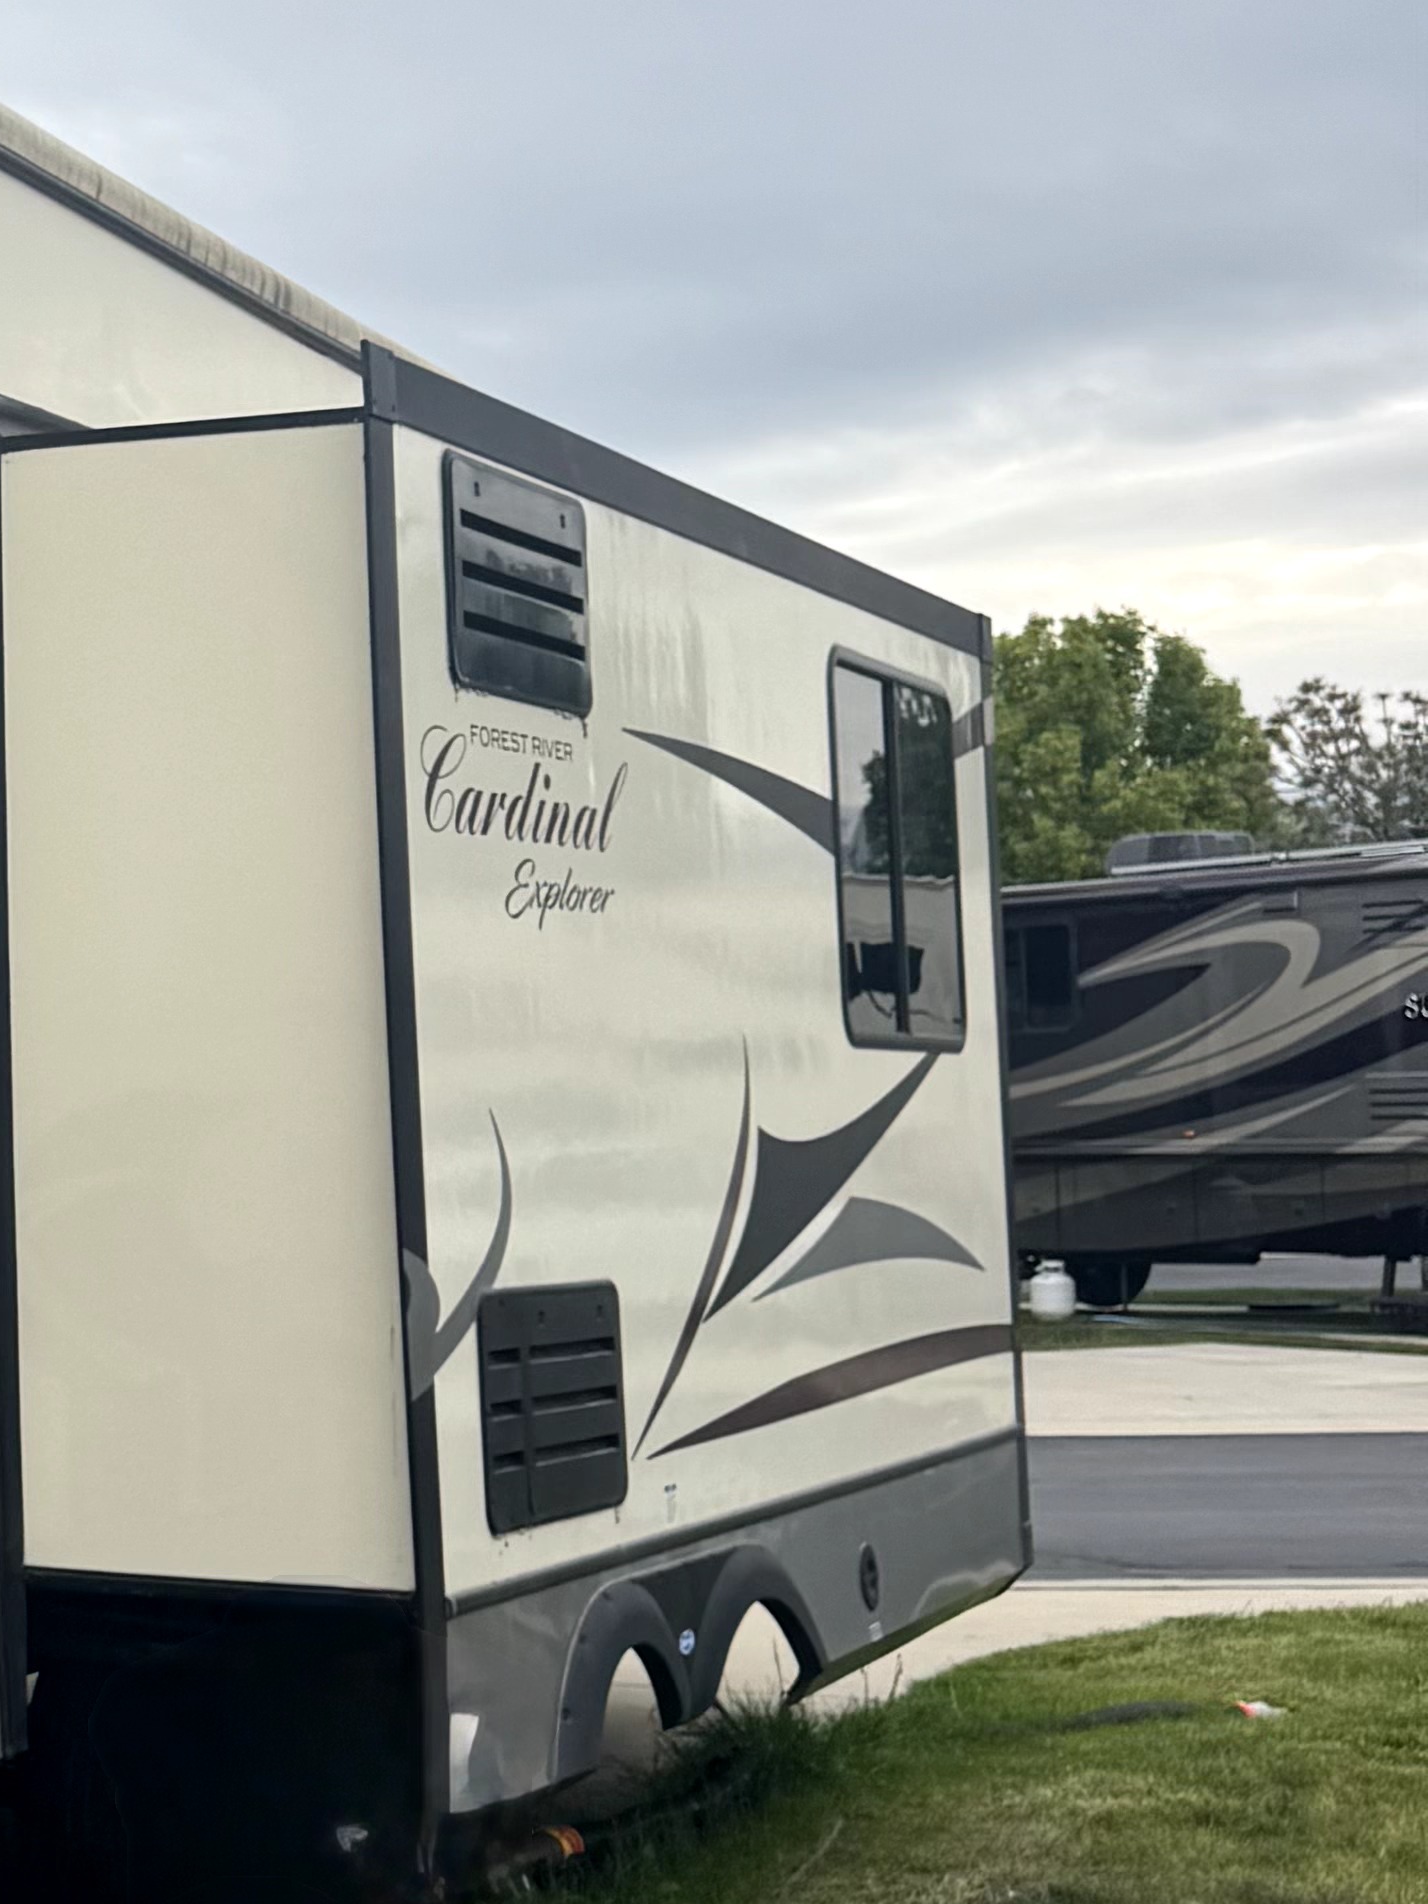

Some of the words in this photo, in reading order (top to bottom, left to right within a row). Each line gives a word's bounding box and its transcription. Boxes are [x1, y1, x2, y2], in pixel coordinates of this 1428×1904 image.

[470, 724, 528, 754] FOREST
[532, 736, 573, 761] RIVER
[420, 724, 628, 852] Cardinal
[505, 858, 615, 930] Explorer
